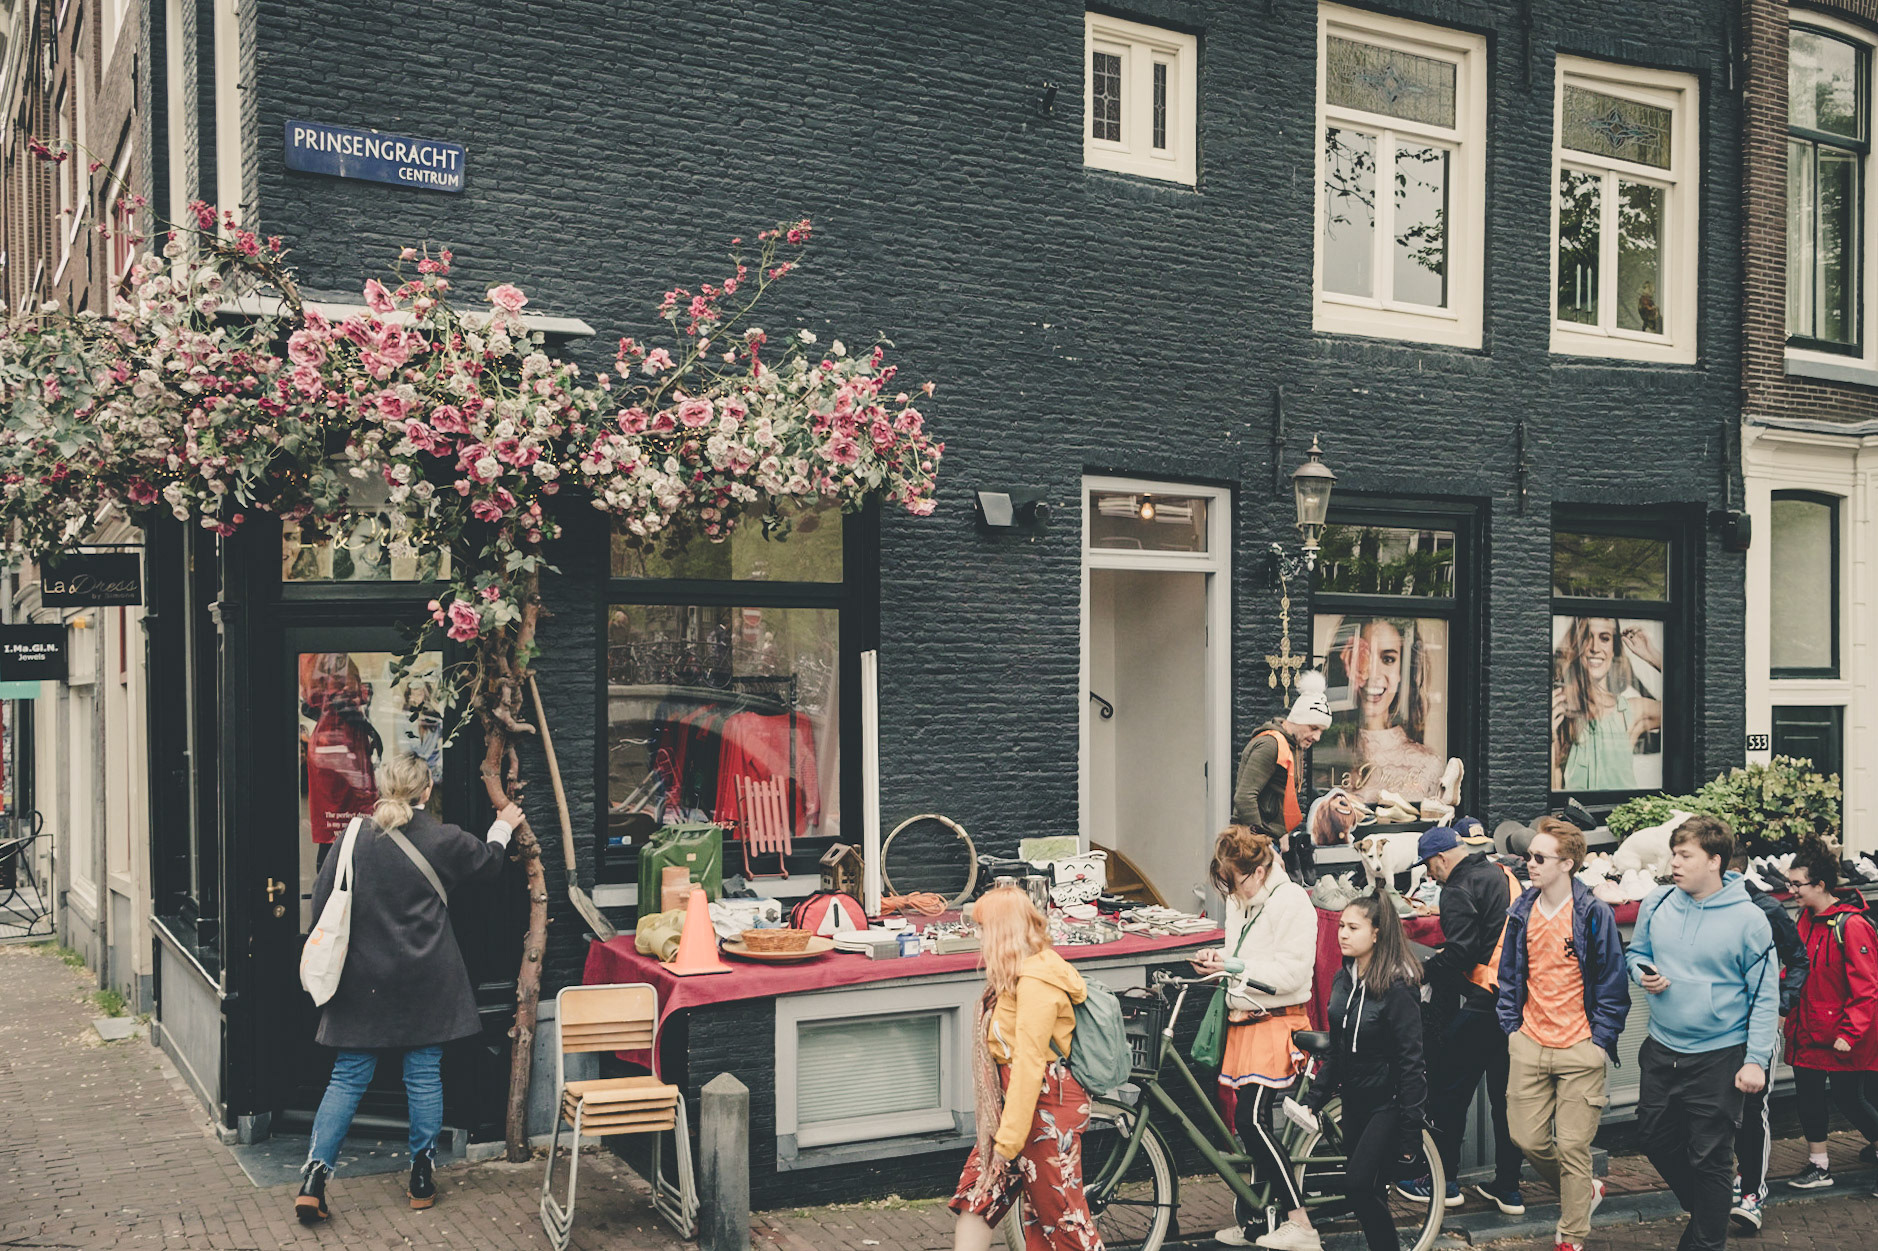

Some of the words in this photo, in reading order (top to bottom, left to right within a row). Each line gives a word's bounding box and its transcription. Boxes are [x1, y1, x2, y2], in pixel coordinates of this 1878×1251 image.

[294, 128, 459, 170] PRINSENGRACHT
[399, 167, 459, 187] CENTRUM
[44, 578, 65, 593] La
[69, 574, 138, 594] Dress
[18, 653, 46, 661] Jewels
[1749, 735, 1767, 749] 533
[1331, 766, 1352, 788] La
